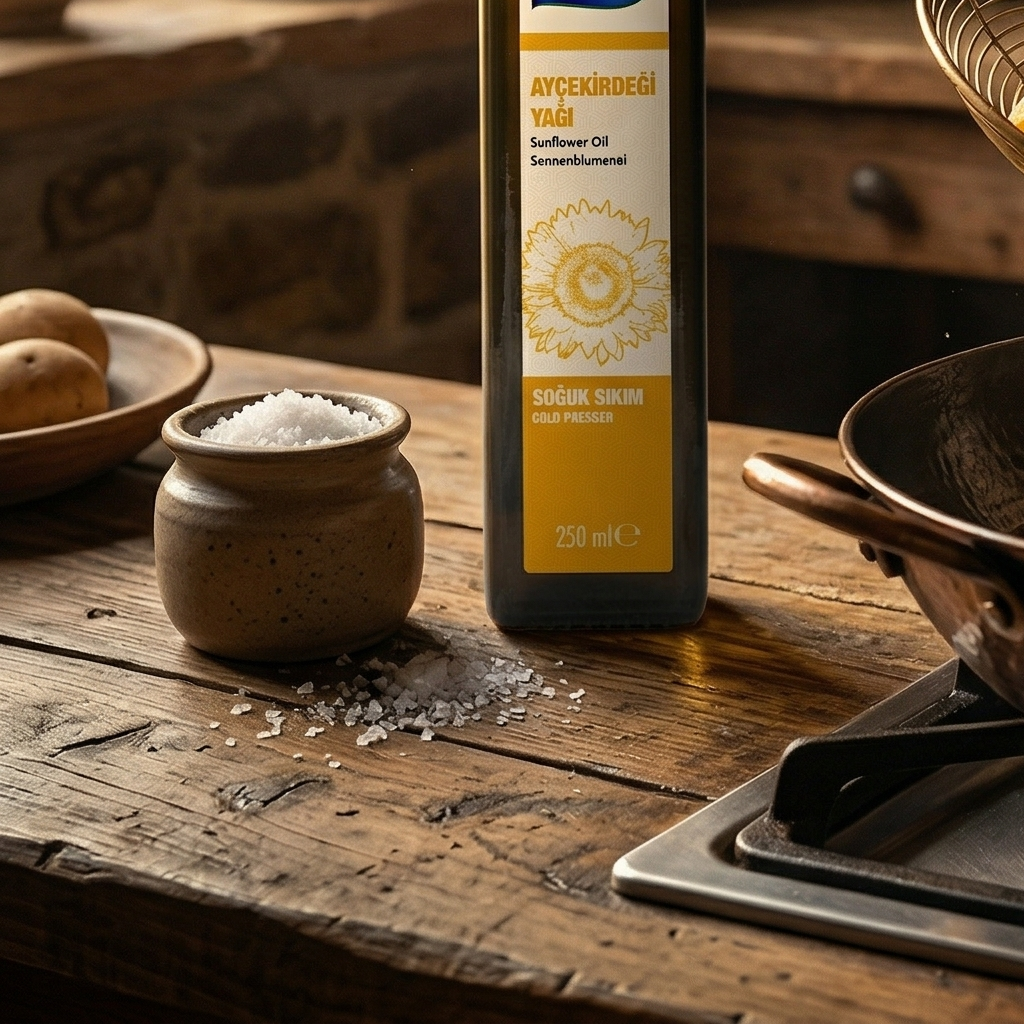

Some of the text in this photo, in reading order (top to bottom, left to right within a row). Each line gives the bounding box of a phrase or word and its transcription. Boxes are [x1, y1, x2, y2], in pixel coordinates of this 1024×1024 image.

[530, 103, 574, 128] YAĞI
[530, 135, 609, 148] Sunflower Oil
[532, 384, 644, 406] SOĞUK SIKIM
[531, 411, 561, 424] COLD
[555, 524, 587, 549] 250
